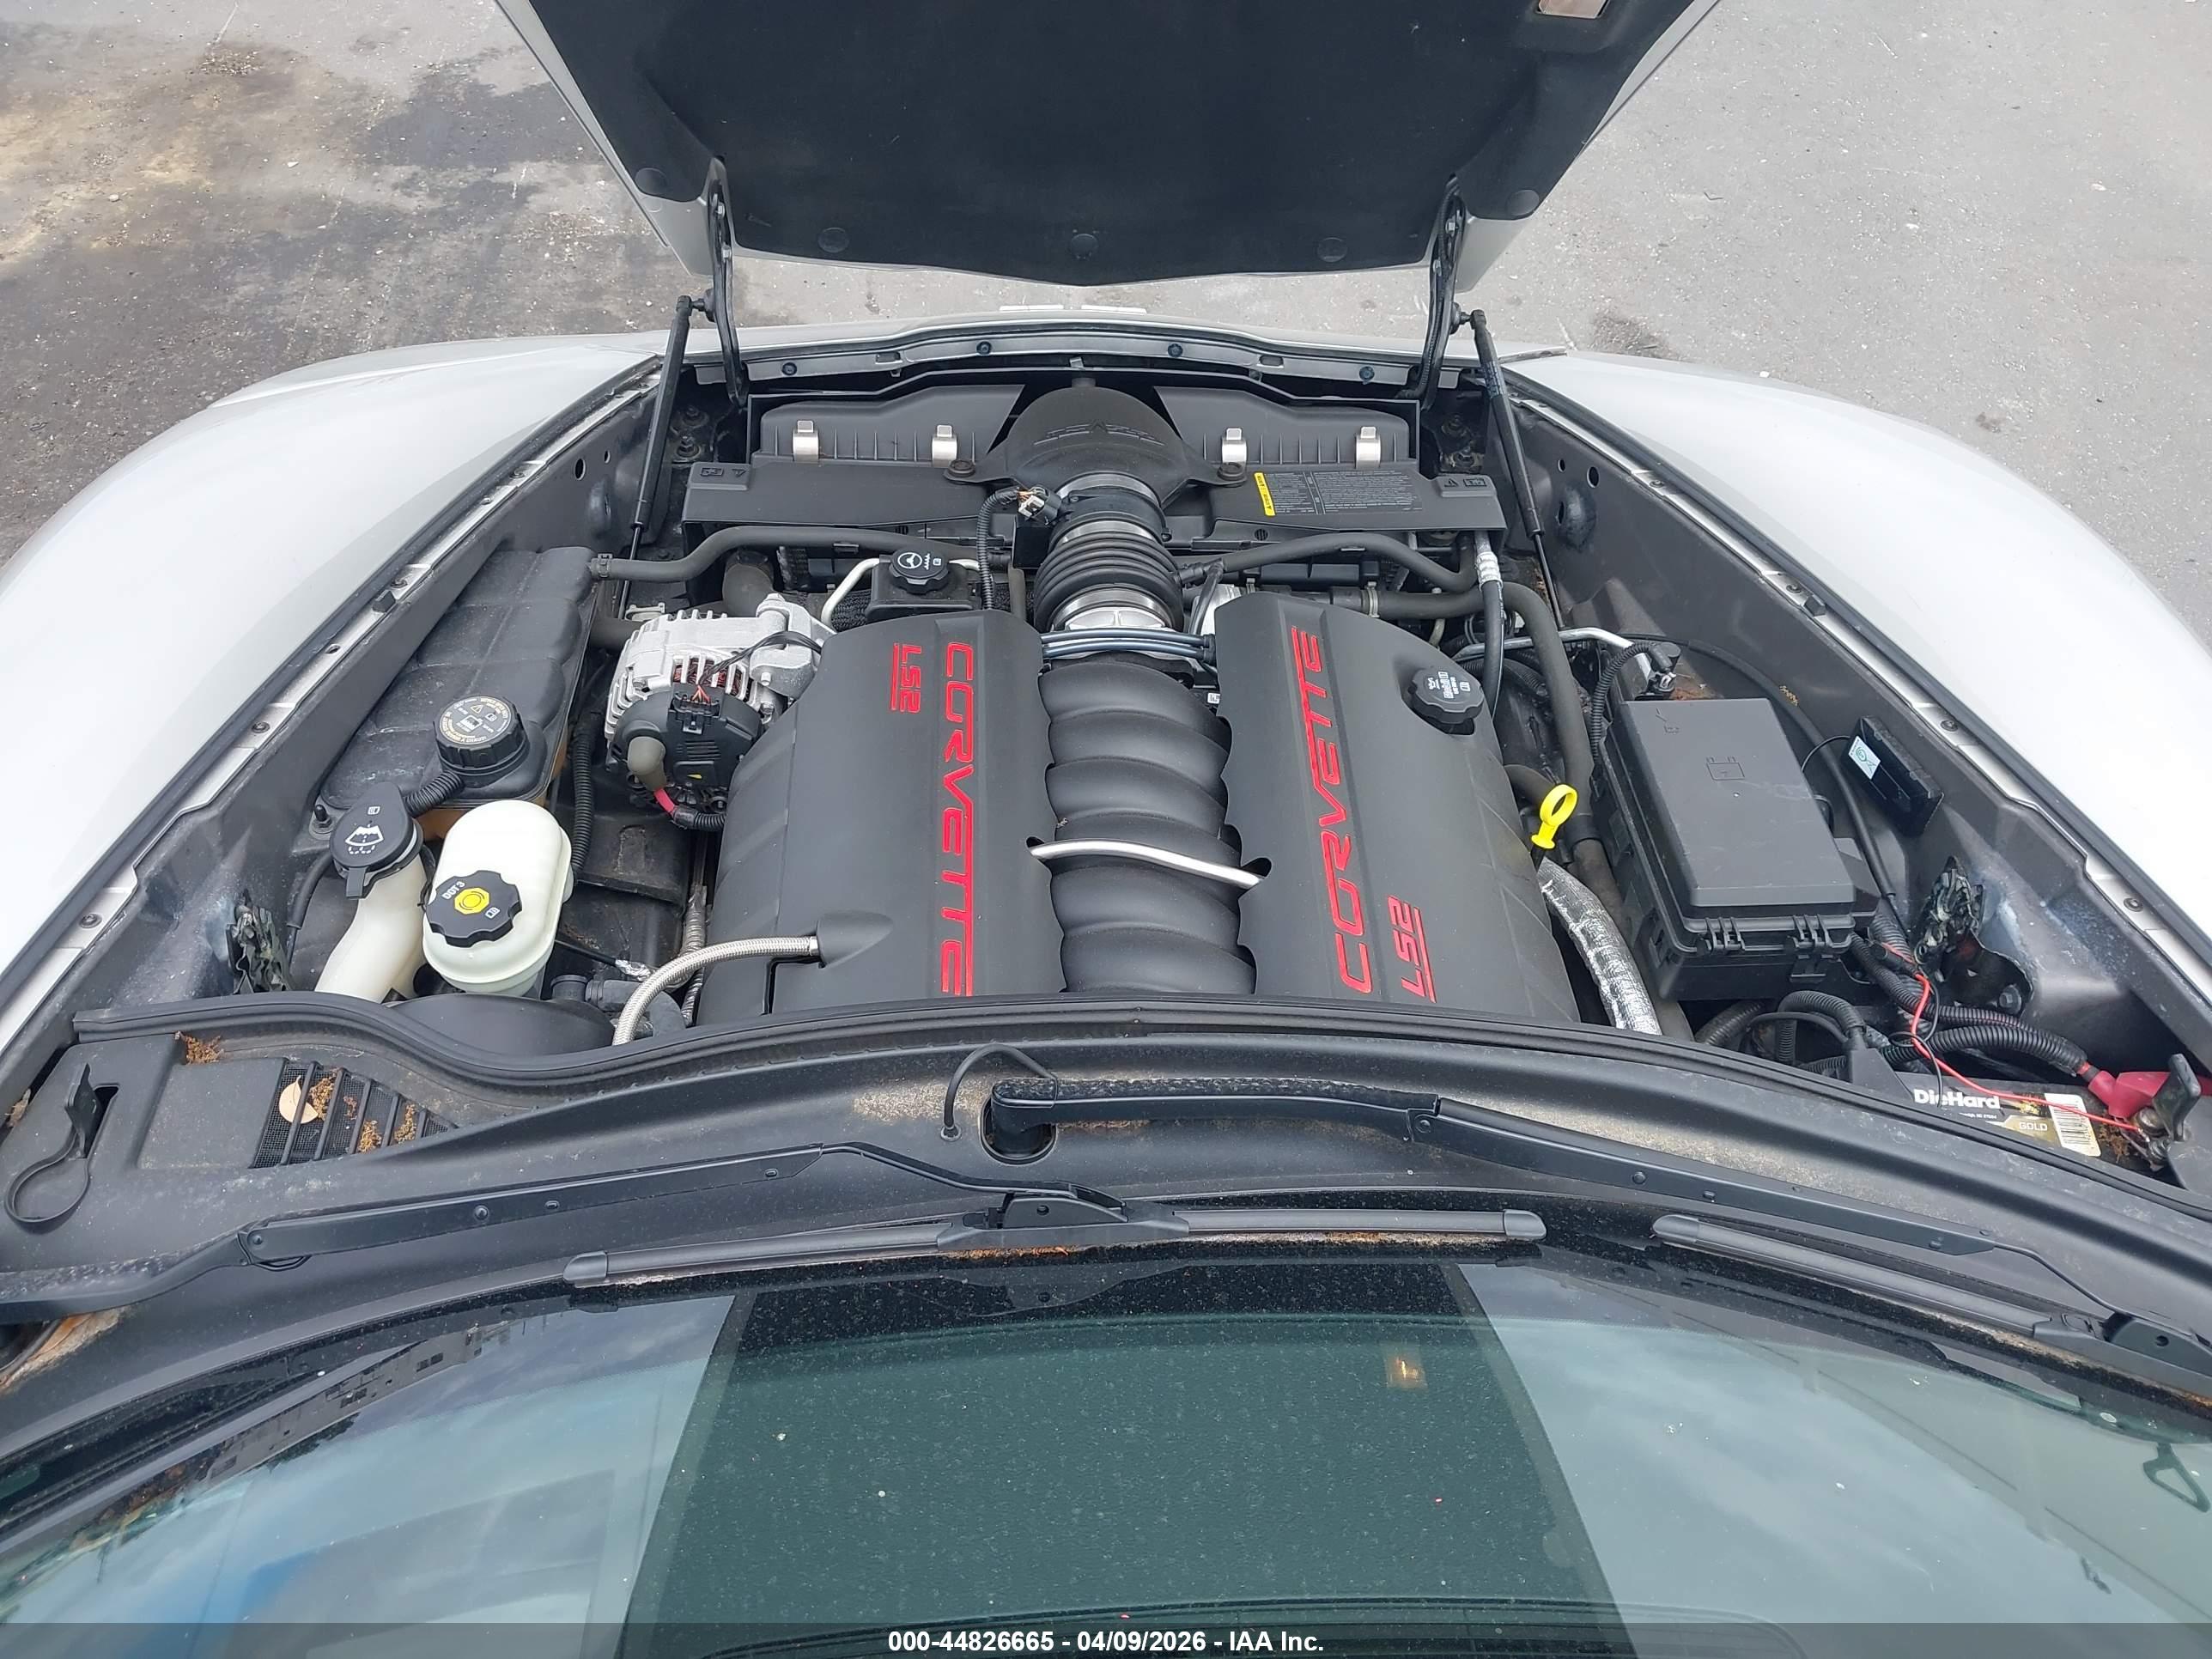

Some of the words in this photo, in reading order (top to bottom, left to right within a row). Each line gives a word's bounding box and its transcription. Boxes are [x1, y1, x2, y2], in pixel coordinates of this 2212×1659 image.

[899, 643, 921, 714] LS2
[941, 642, 975, 997] CORVETTE
[1291, 627, 1373, 993] CORVETTE
[441, 884, 460, 900] DOT
[1388, 896, 1426, 998] LS2
[1913, 1089, 2001, 1109] DieHard
[2019, 1121, 2048, 1132] GOLD
